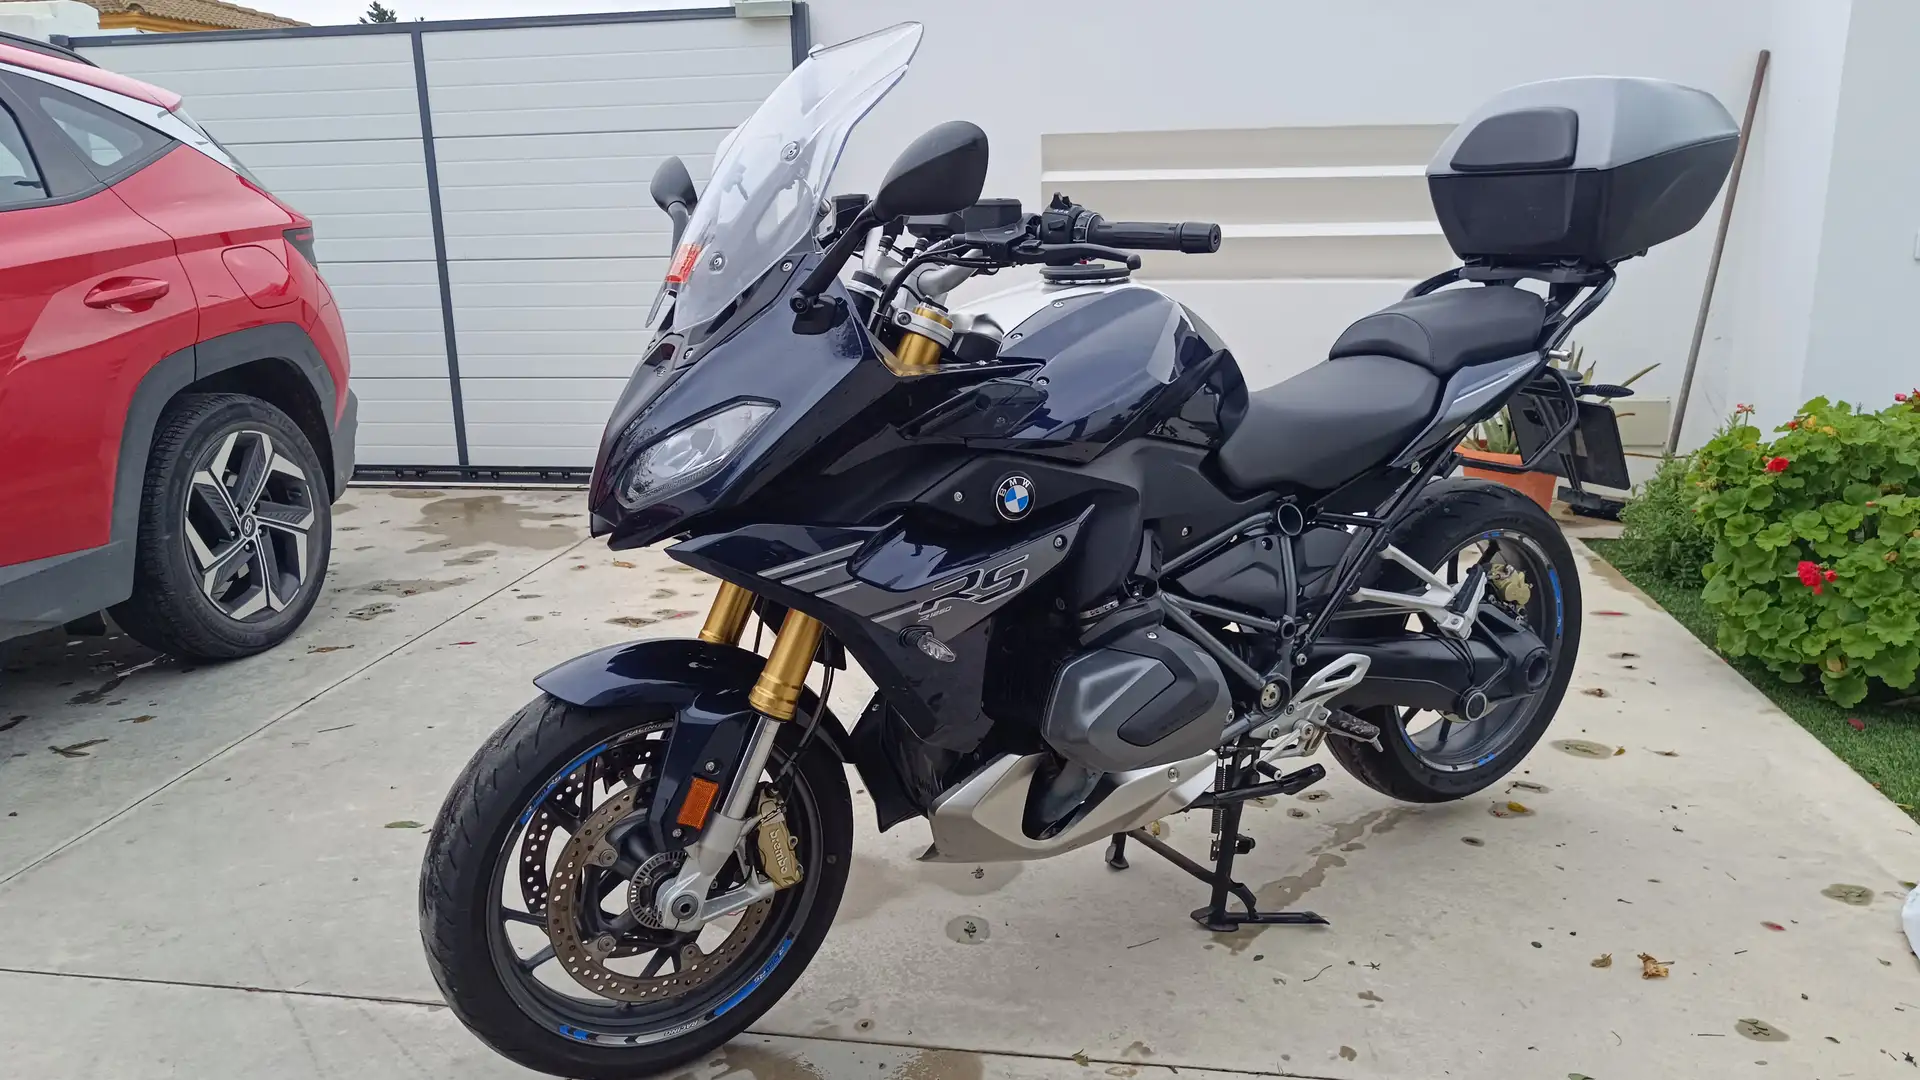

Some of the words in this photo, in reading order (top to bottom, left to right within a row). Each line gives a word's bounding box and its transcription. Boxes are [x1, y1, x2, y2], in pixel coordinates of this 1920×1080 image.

[999, 478, 1031, 497] BMW
[918, 554, 1030, 614] RS
[769, 828, 788, 874] brembo
[664, 1020, 699, 1036] RACING
